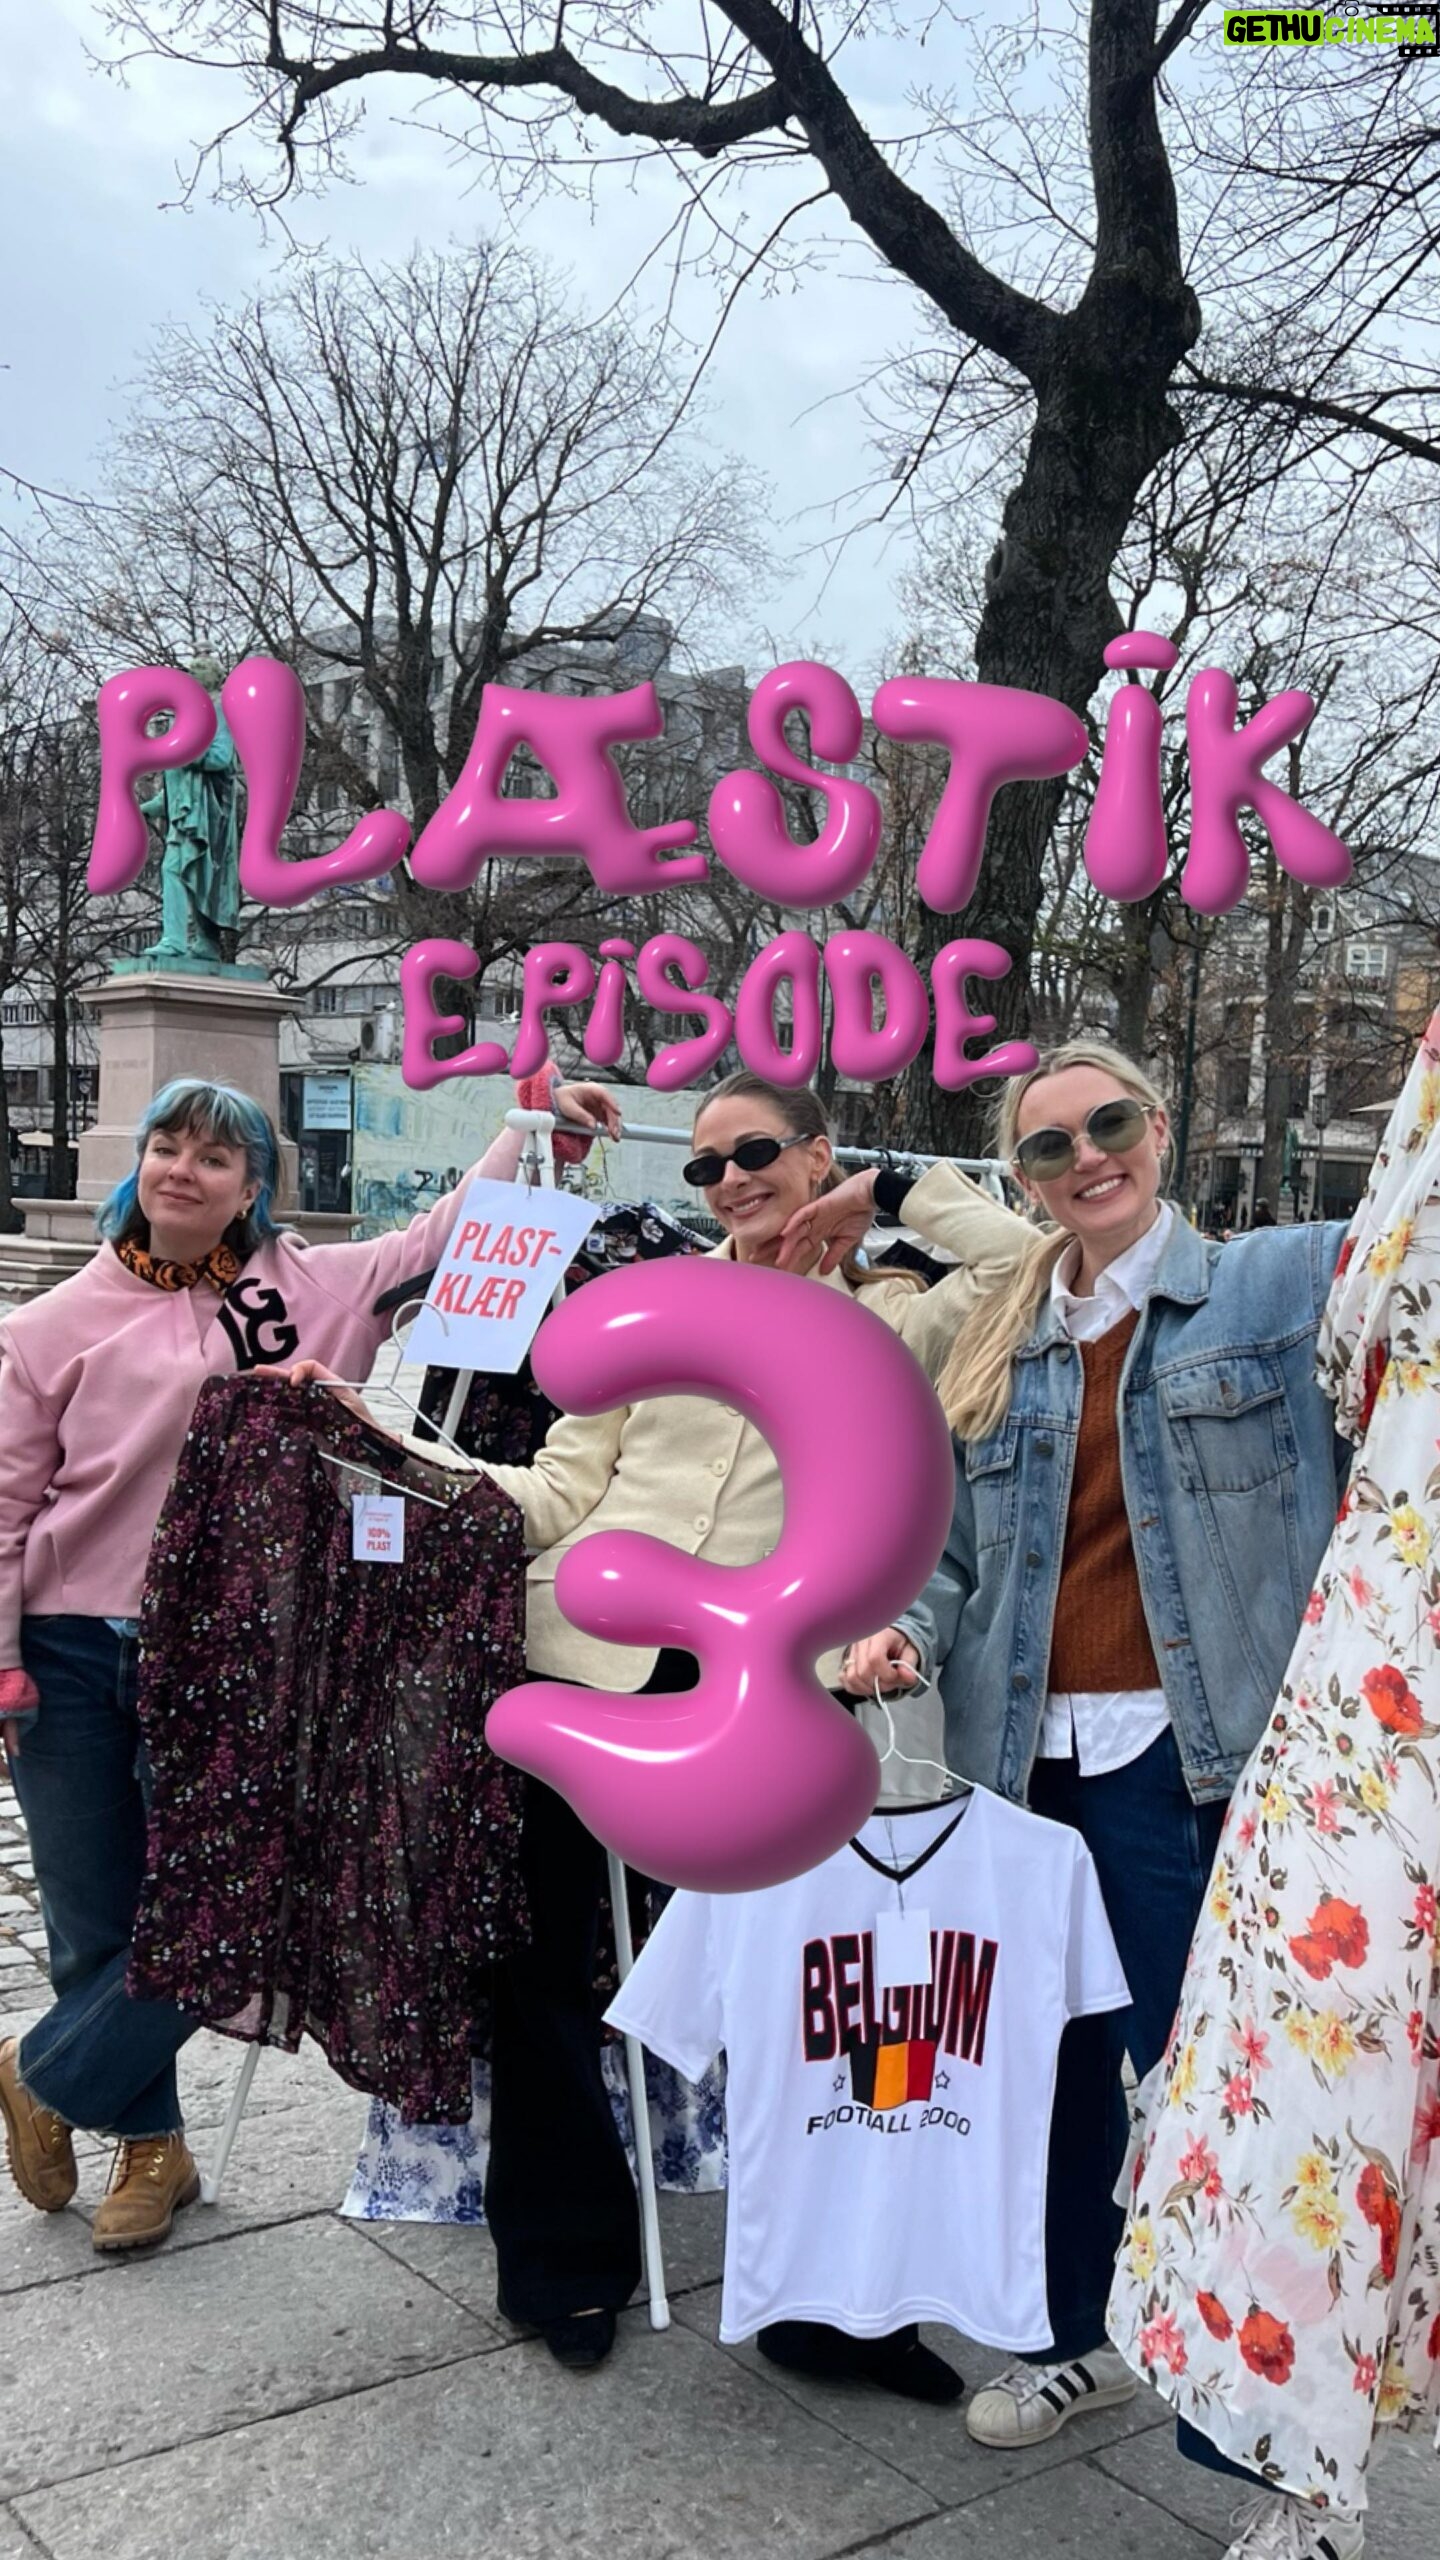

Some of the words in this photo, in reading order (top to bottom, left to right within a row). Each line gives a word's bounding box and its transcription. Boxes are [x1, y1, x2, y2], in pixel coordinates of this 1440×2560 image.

[452, 1220, 563, 1268] PLAST-
[433, 1271, 527, 1320] KLÆR
[366, 1540, 391, 1551] PLAST
[919, 2106, 972, 2136] 2000
